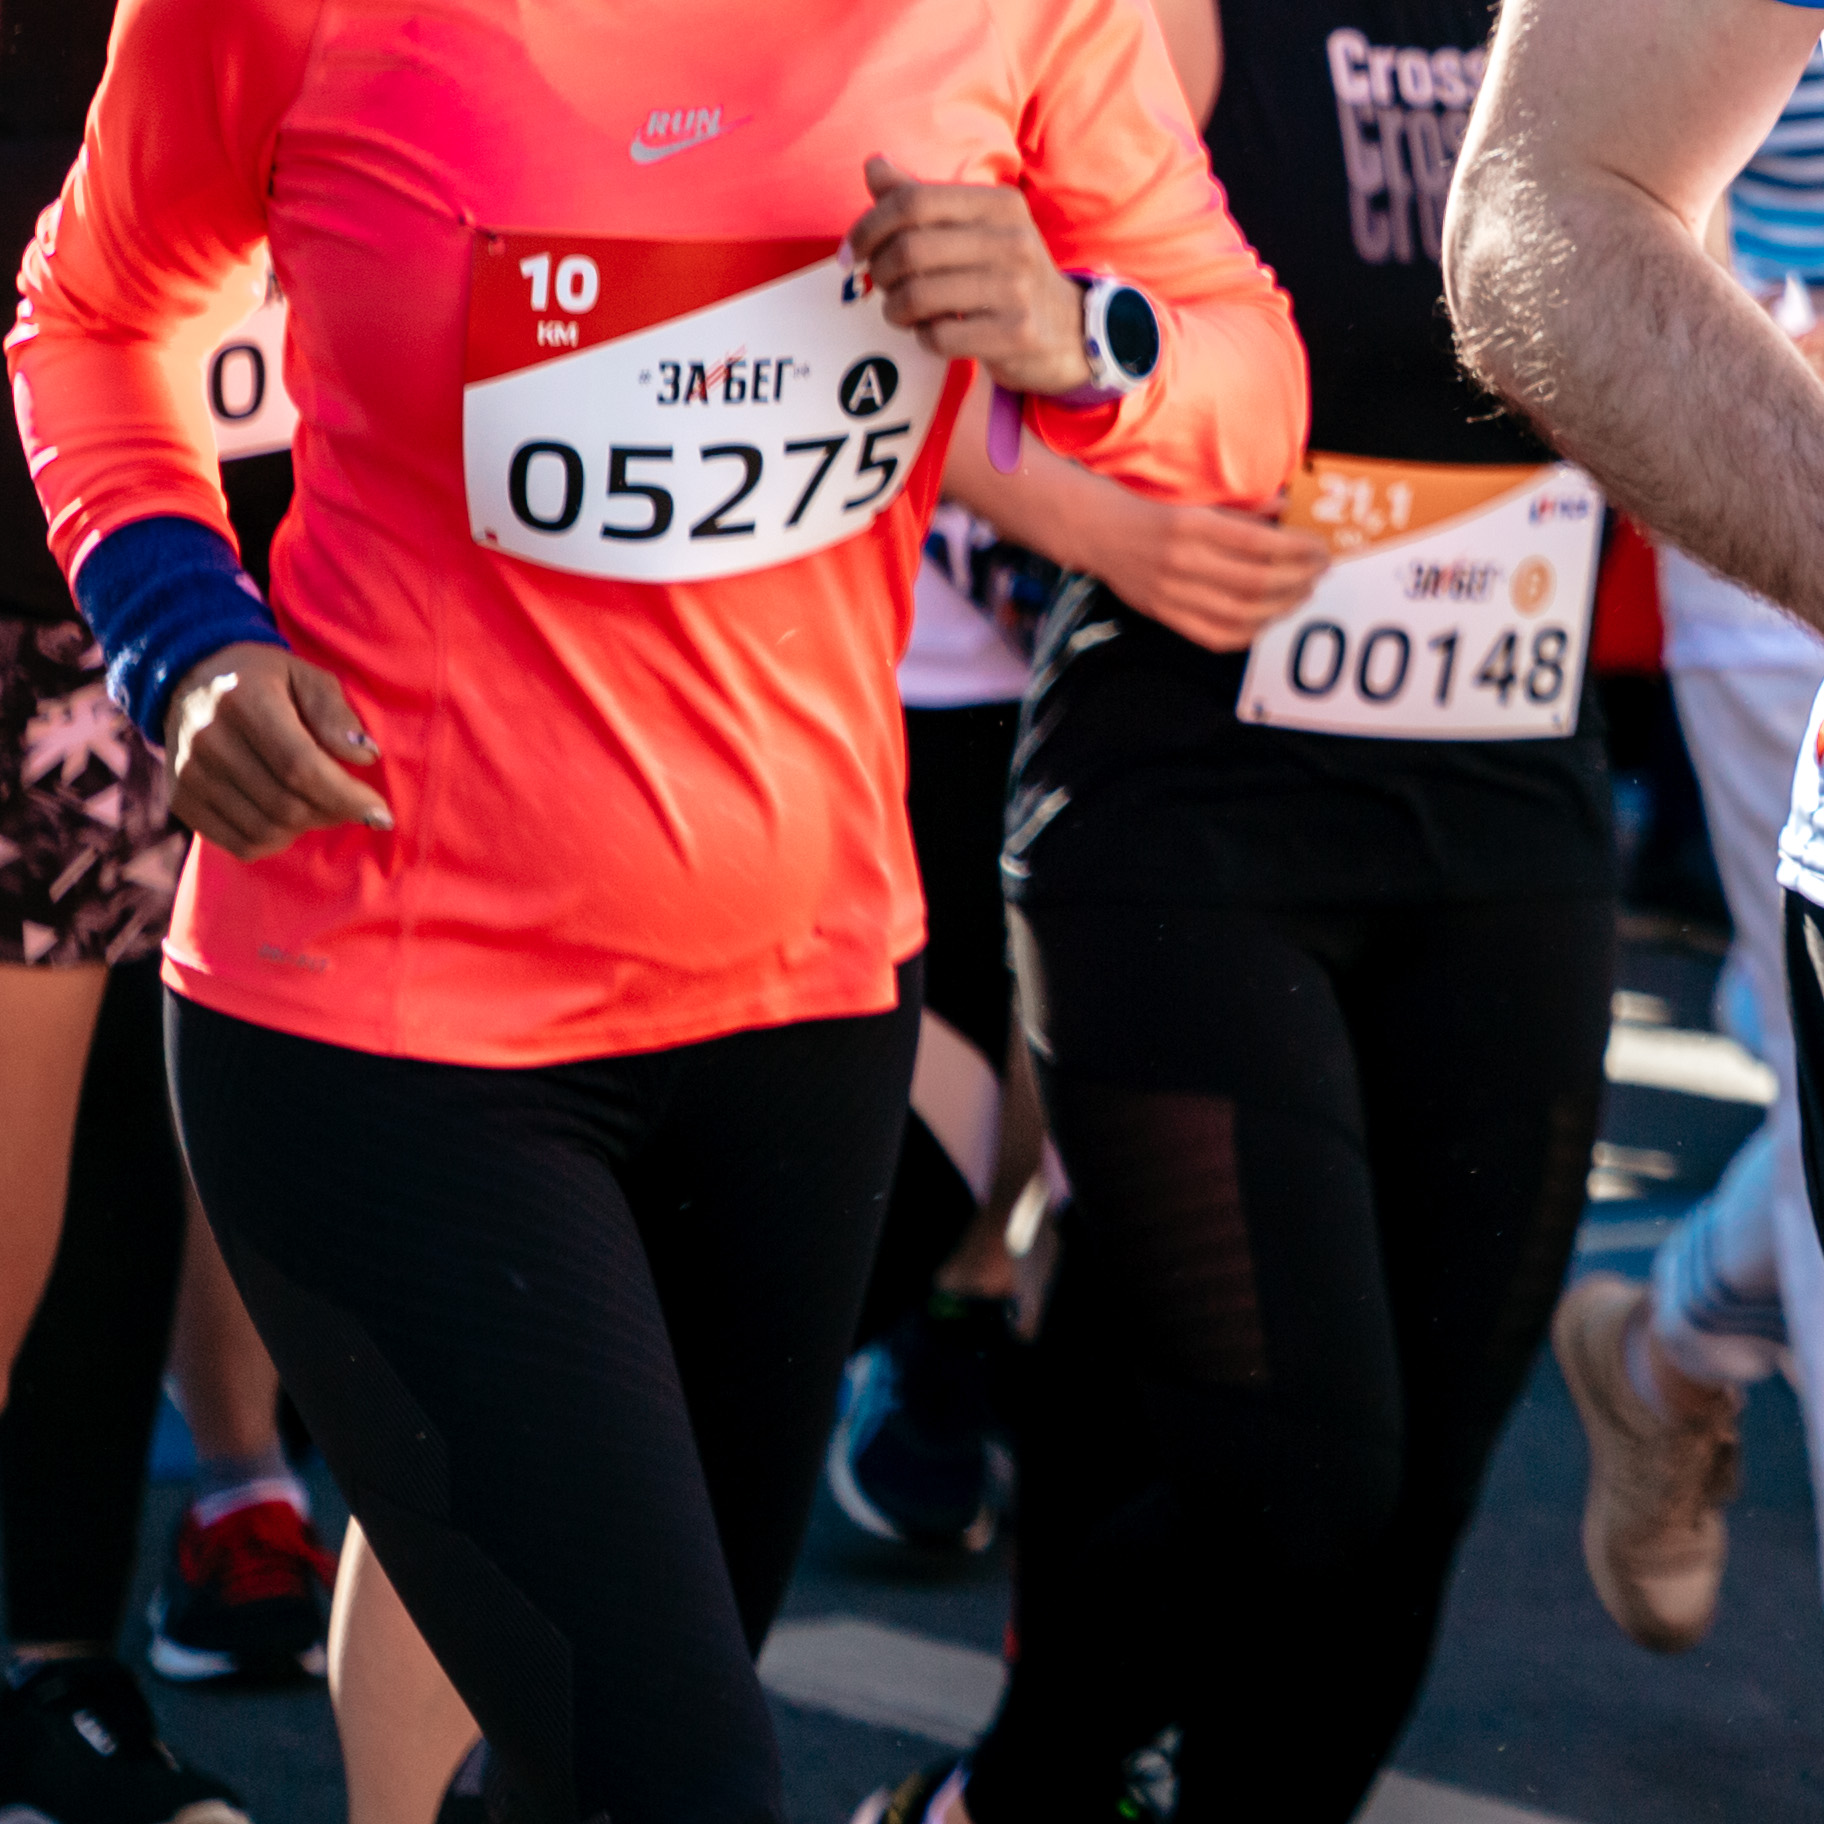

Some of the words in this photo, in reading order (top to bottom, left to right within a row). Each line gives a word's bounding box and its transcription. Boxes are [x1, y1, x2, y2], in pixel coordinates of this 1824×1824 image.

[520, 251, 599, 313] 10
[507, 421, 911, 541] 05275
[1287, 621, 1571, 708] 00148
